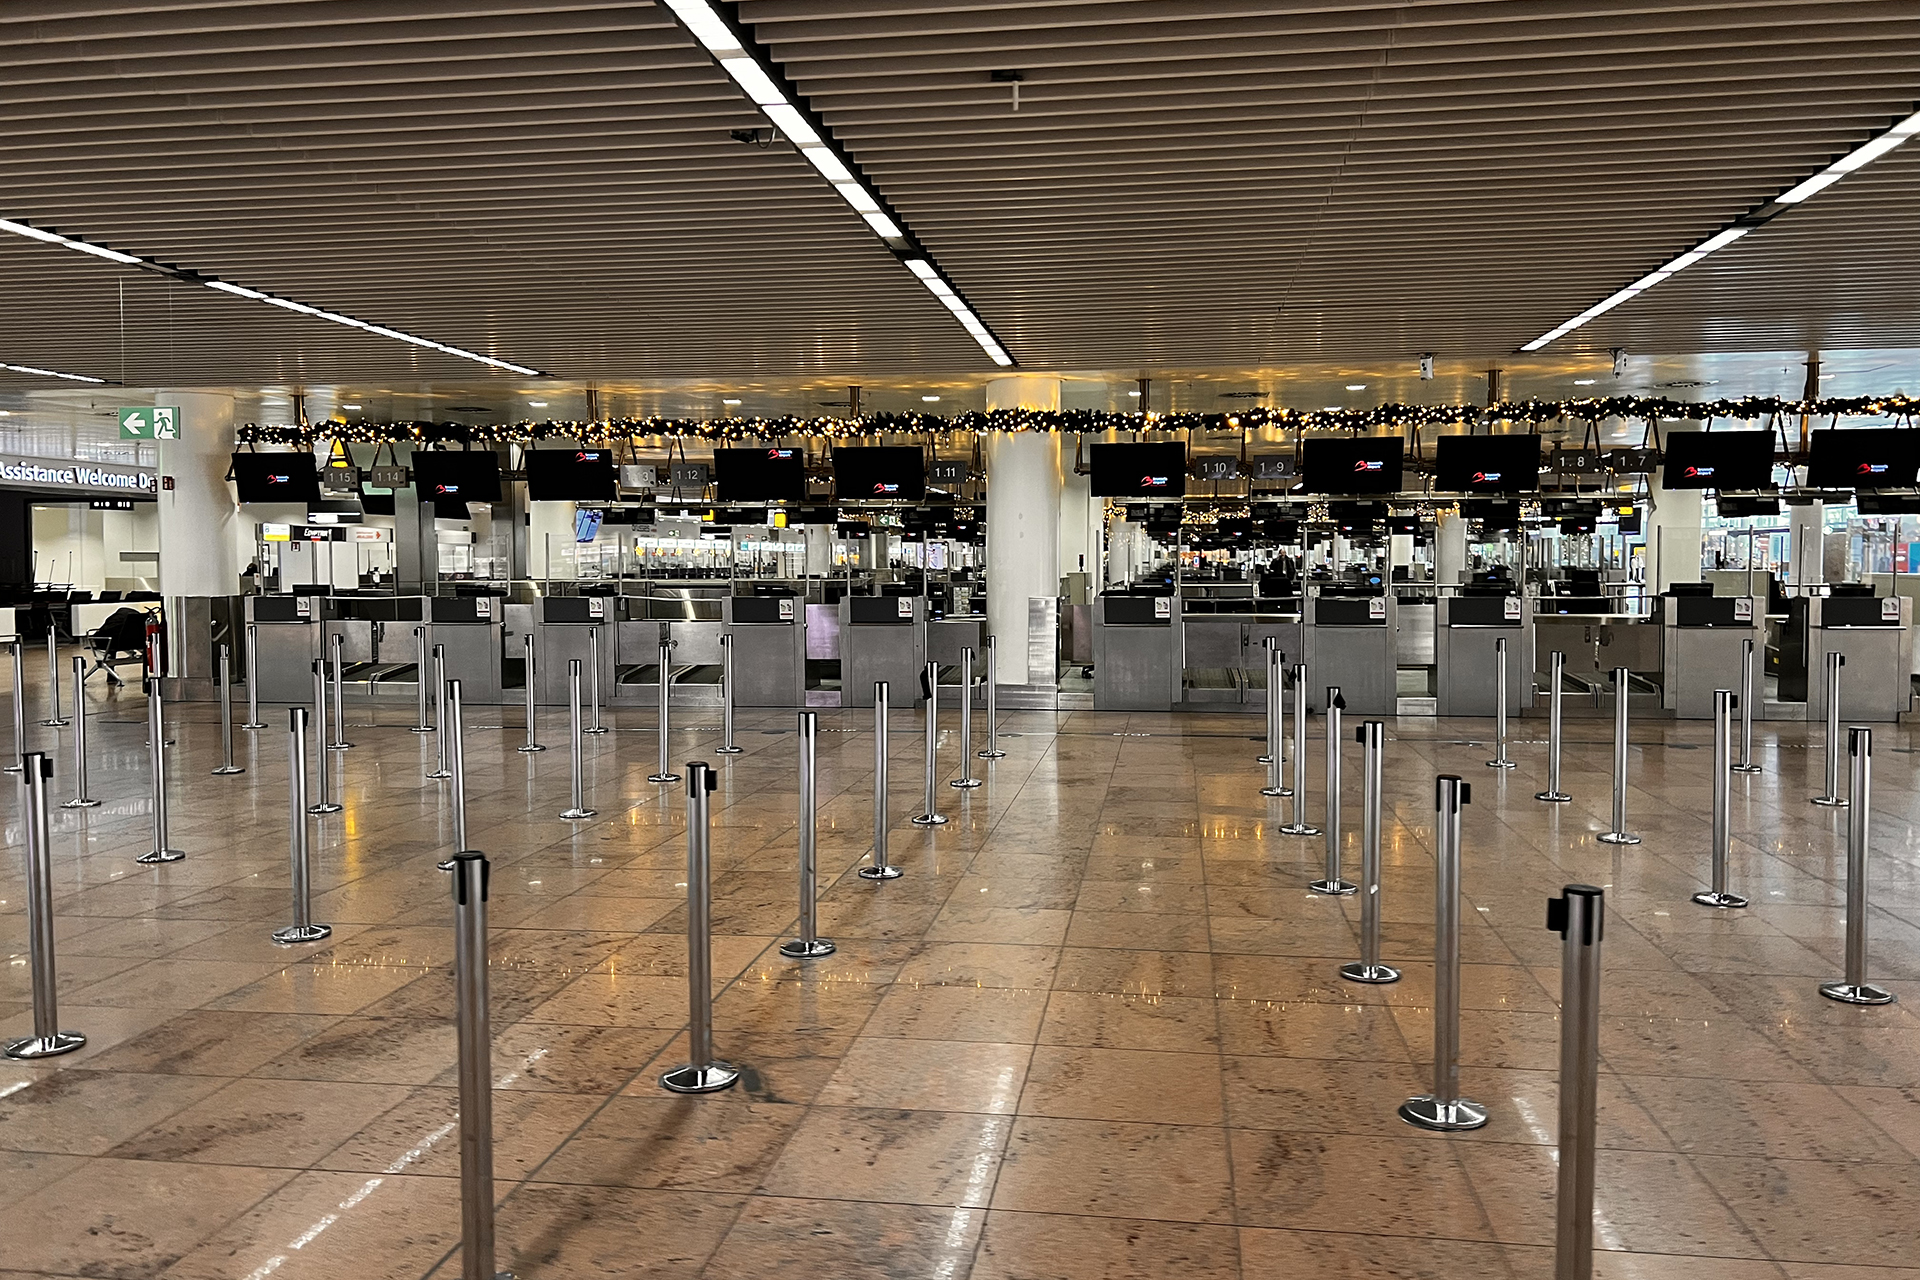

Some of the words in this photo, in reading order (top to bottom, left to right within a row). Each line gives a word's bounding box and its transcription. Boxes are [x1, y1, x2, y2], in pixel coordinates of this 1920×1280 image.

[935, 467, 955, 477] 1.11
[1203, 462, 1227, 473] 1.10
[0, 461, 73, 483] Assistance
[75, 467, 137, 488] Welcome
[377, 472, 399, 482] 1.14
[677, 470, 698, 480] 1.12
